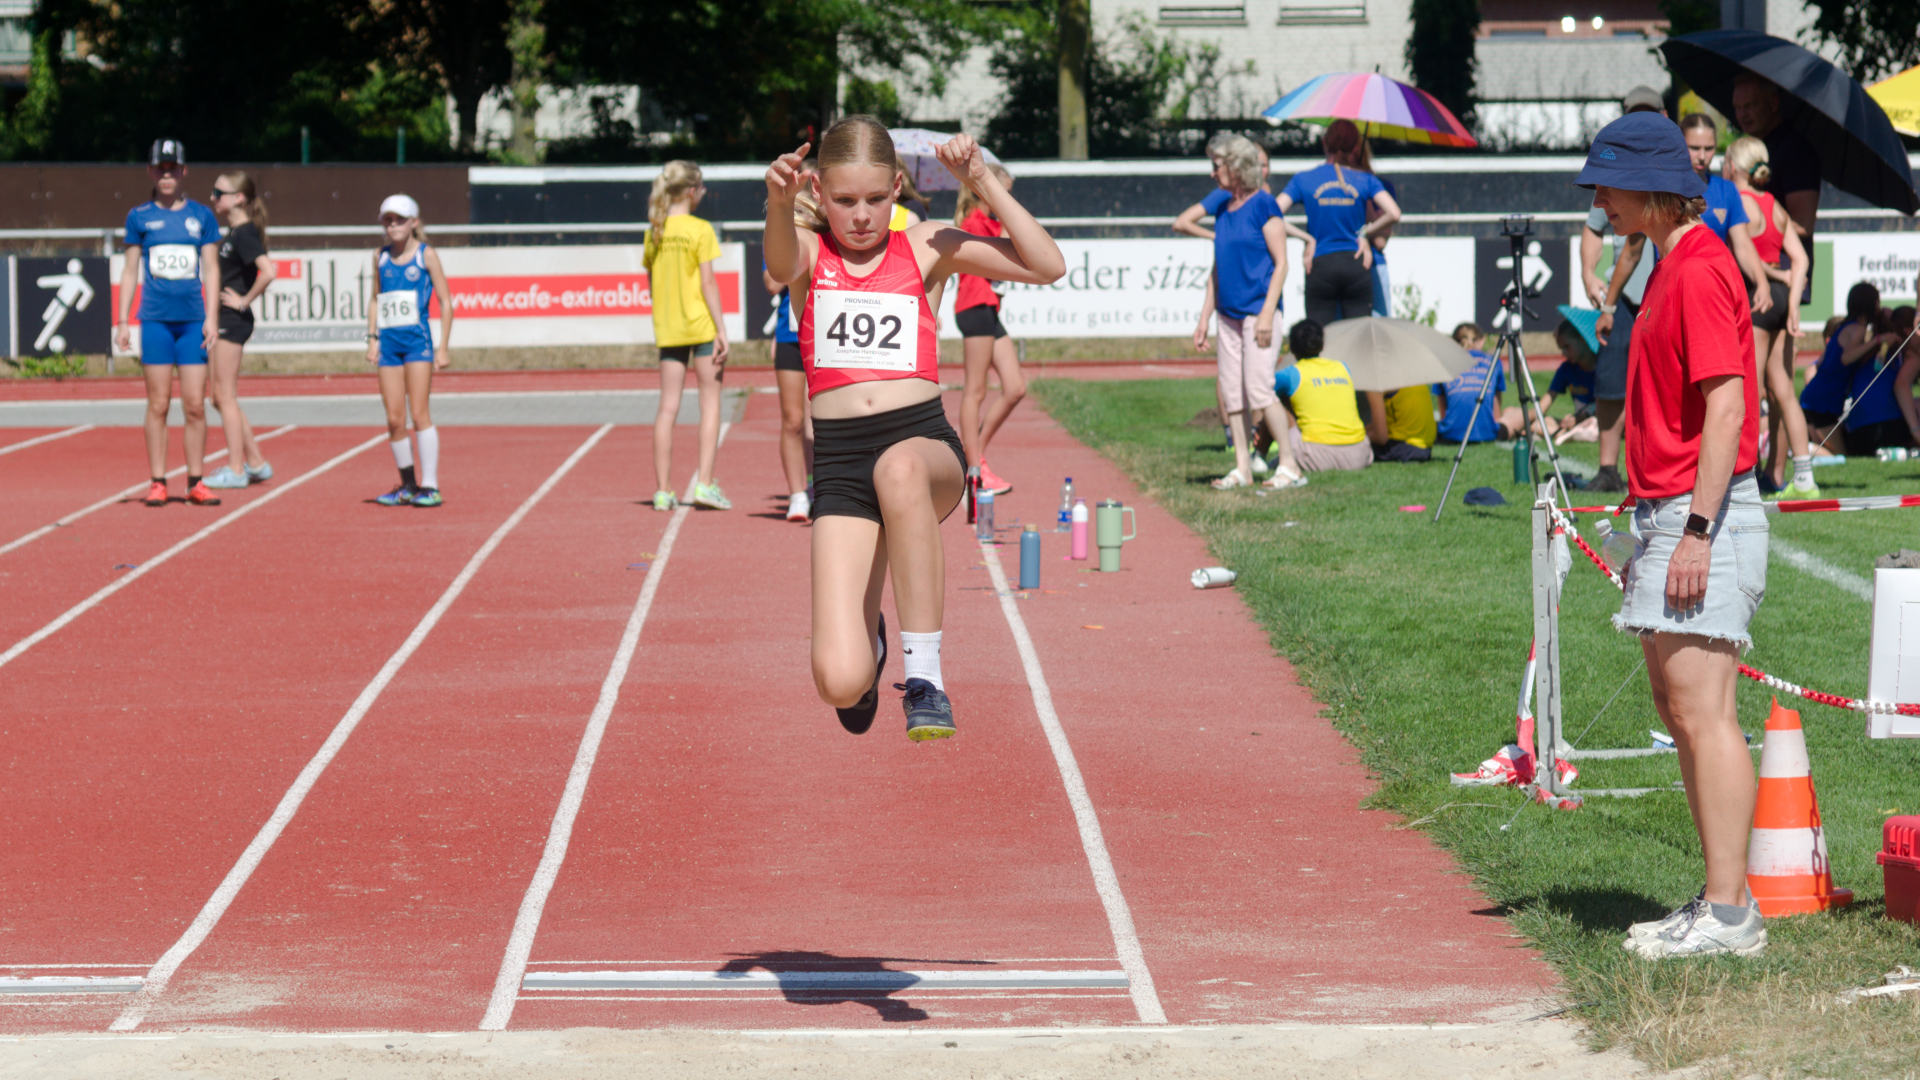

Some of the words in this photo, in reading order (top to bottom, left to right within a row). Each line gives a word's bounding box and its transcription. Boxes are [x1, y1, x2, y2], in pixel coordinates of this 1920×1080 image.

[157, 255, 189, 270] 520
[1859, 253, 1919, 272] Ferdina
[255, 258, 374, 321] trablat
[817, 279, 838, 287] erima
[451, 282, 651, 310] www.cafe-extrabla
[844, 297, 881, 305] PROVINZIAL
[381, 300, 410, 318] 516
[1005, 306, 1036, 324] bel
[1047, 306, 1077, 324] für
[1087, 309, 1134, 329] gute
[826, 312, 902, 349] 492
